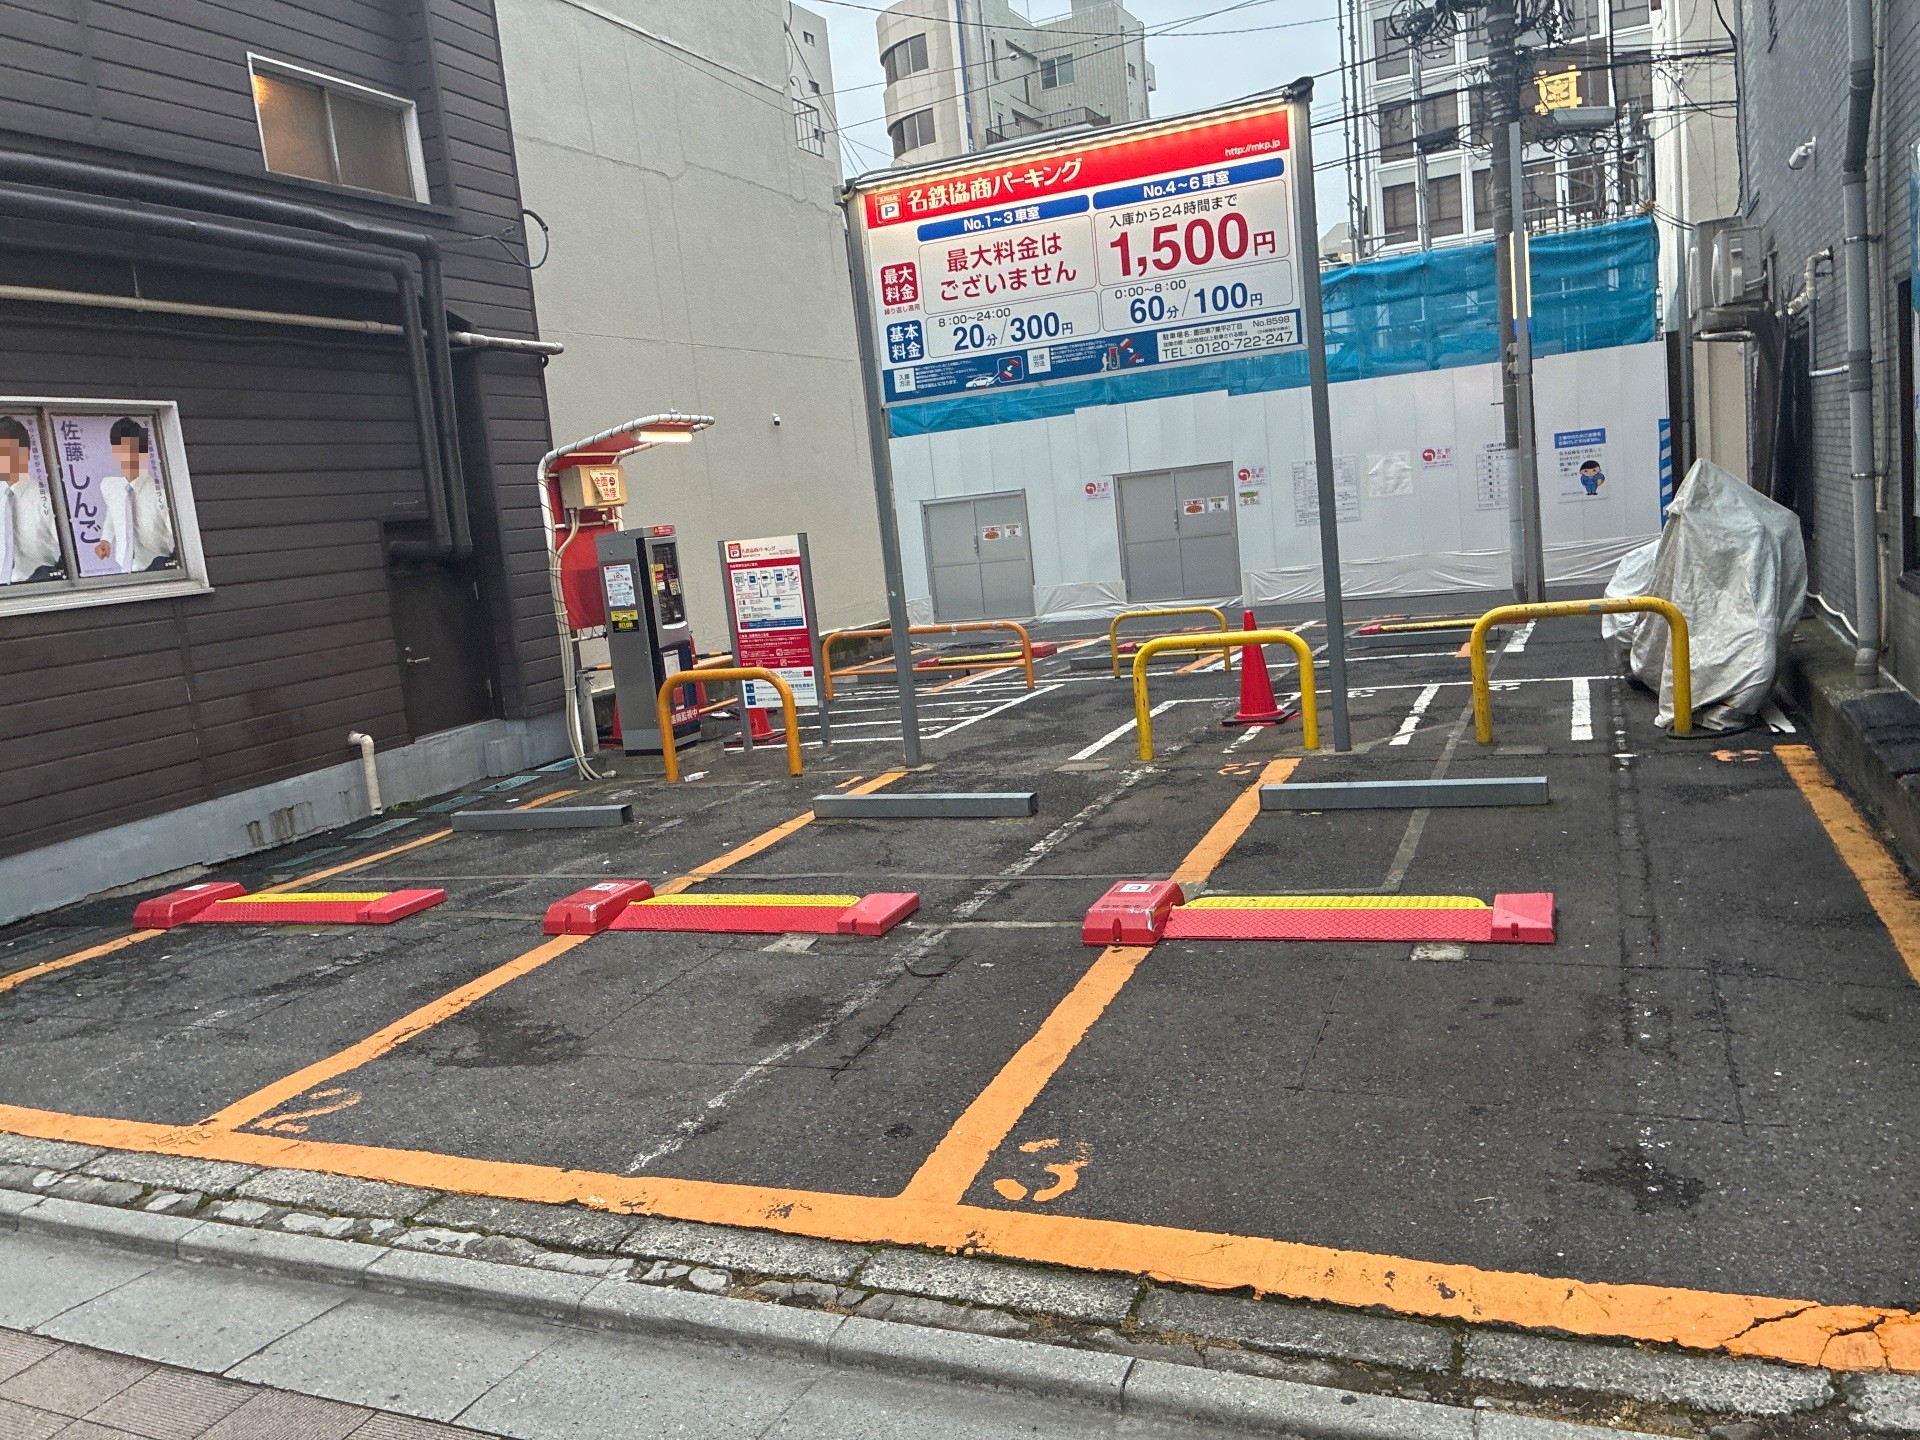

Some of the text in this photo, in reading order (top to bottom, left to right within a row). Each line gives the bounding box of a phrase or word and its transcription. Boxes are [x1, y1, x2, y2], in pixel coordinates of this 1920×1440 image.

[1225, 138, 1281, 157] http://mkp.jp
[906, 157, 1083, 214] 名鉄協商パーキング
[1110, 194, 1238, 229] 入庫から24時間まで
[946, 232, 1064, 273] 最大料金は
[883, 266, 914, 285] 最大
[940, 261, 1078, 302] ございません
[886, 283, 916, 302] 料金
[889, 323, 920, 342] 基本
[1252, 315, 1290, 328] No.8598
[892, 343, 922, 364] 料金
[61, 420, 102, 545] 佐藤しんご
[988, 1137, 1093, 1203] 3
